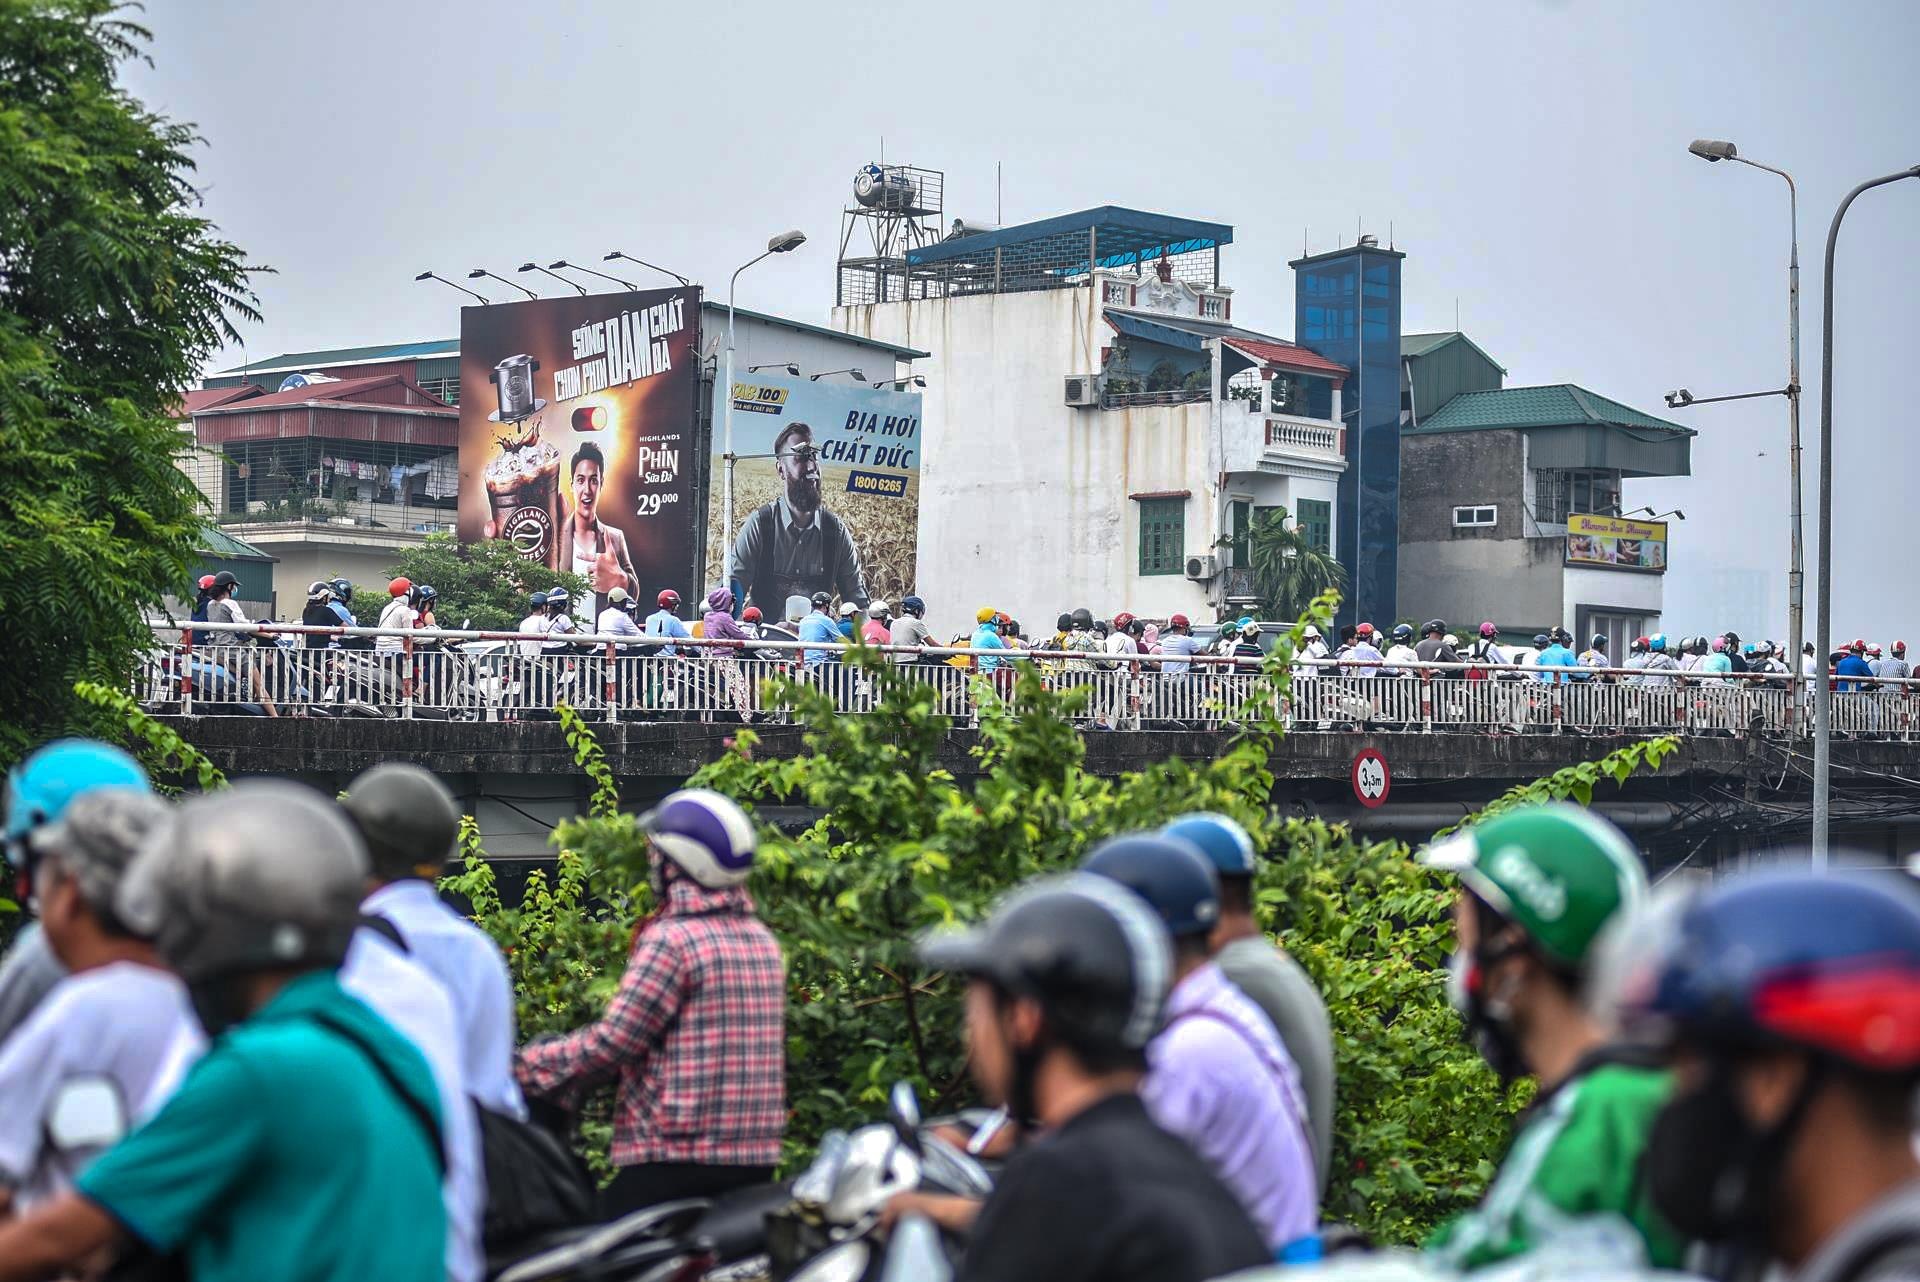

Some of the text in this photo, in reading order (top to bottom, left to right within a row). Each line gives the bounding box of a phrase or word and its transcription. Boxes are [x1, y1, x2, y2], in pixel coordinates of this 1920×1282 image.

[572, 294, 684, 389] SỐNG ĐẬM CHẤT
[582, 357, 608, 395] PHIN
[757, 387, 781, 401] 100
[845, 410, 917, 438] BIA HƠI
[640, 434, 680, 443] HIGHLANDS
[639, 444, 679, 477] PHIN
[821, 436, 913, 469] CHẤT ĐỨC
[660, 470, 673, 483] Đá
[855, 476, 902, 493] 1800 6265
[637, 493, 678, 515] 29.000
[505, 510, 550, 537] HIGHLANDS
[517, 545, 545, 560] OFFEE
[1362, 768, 1381, 790] 3,3m
